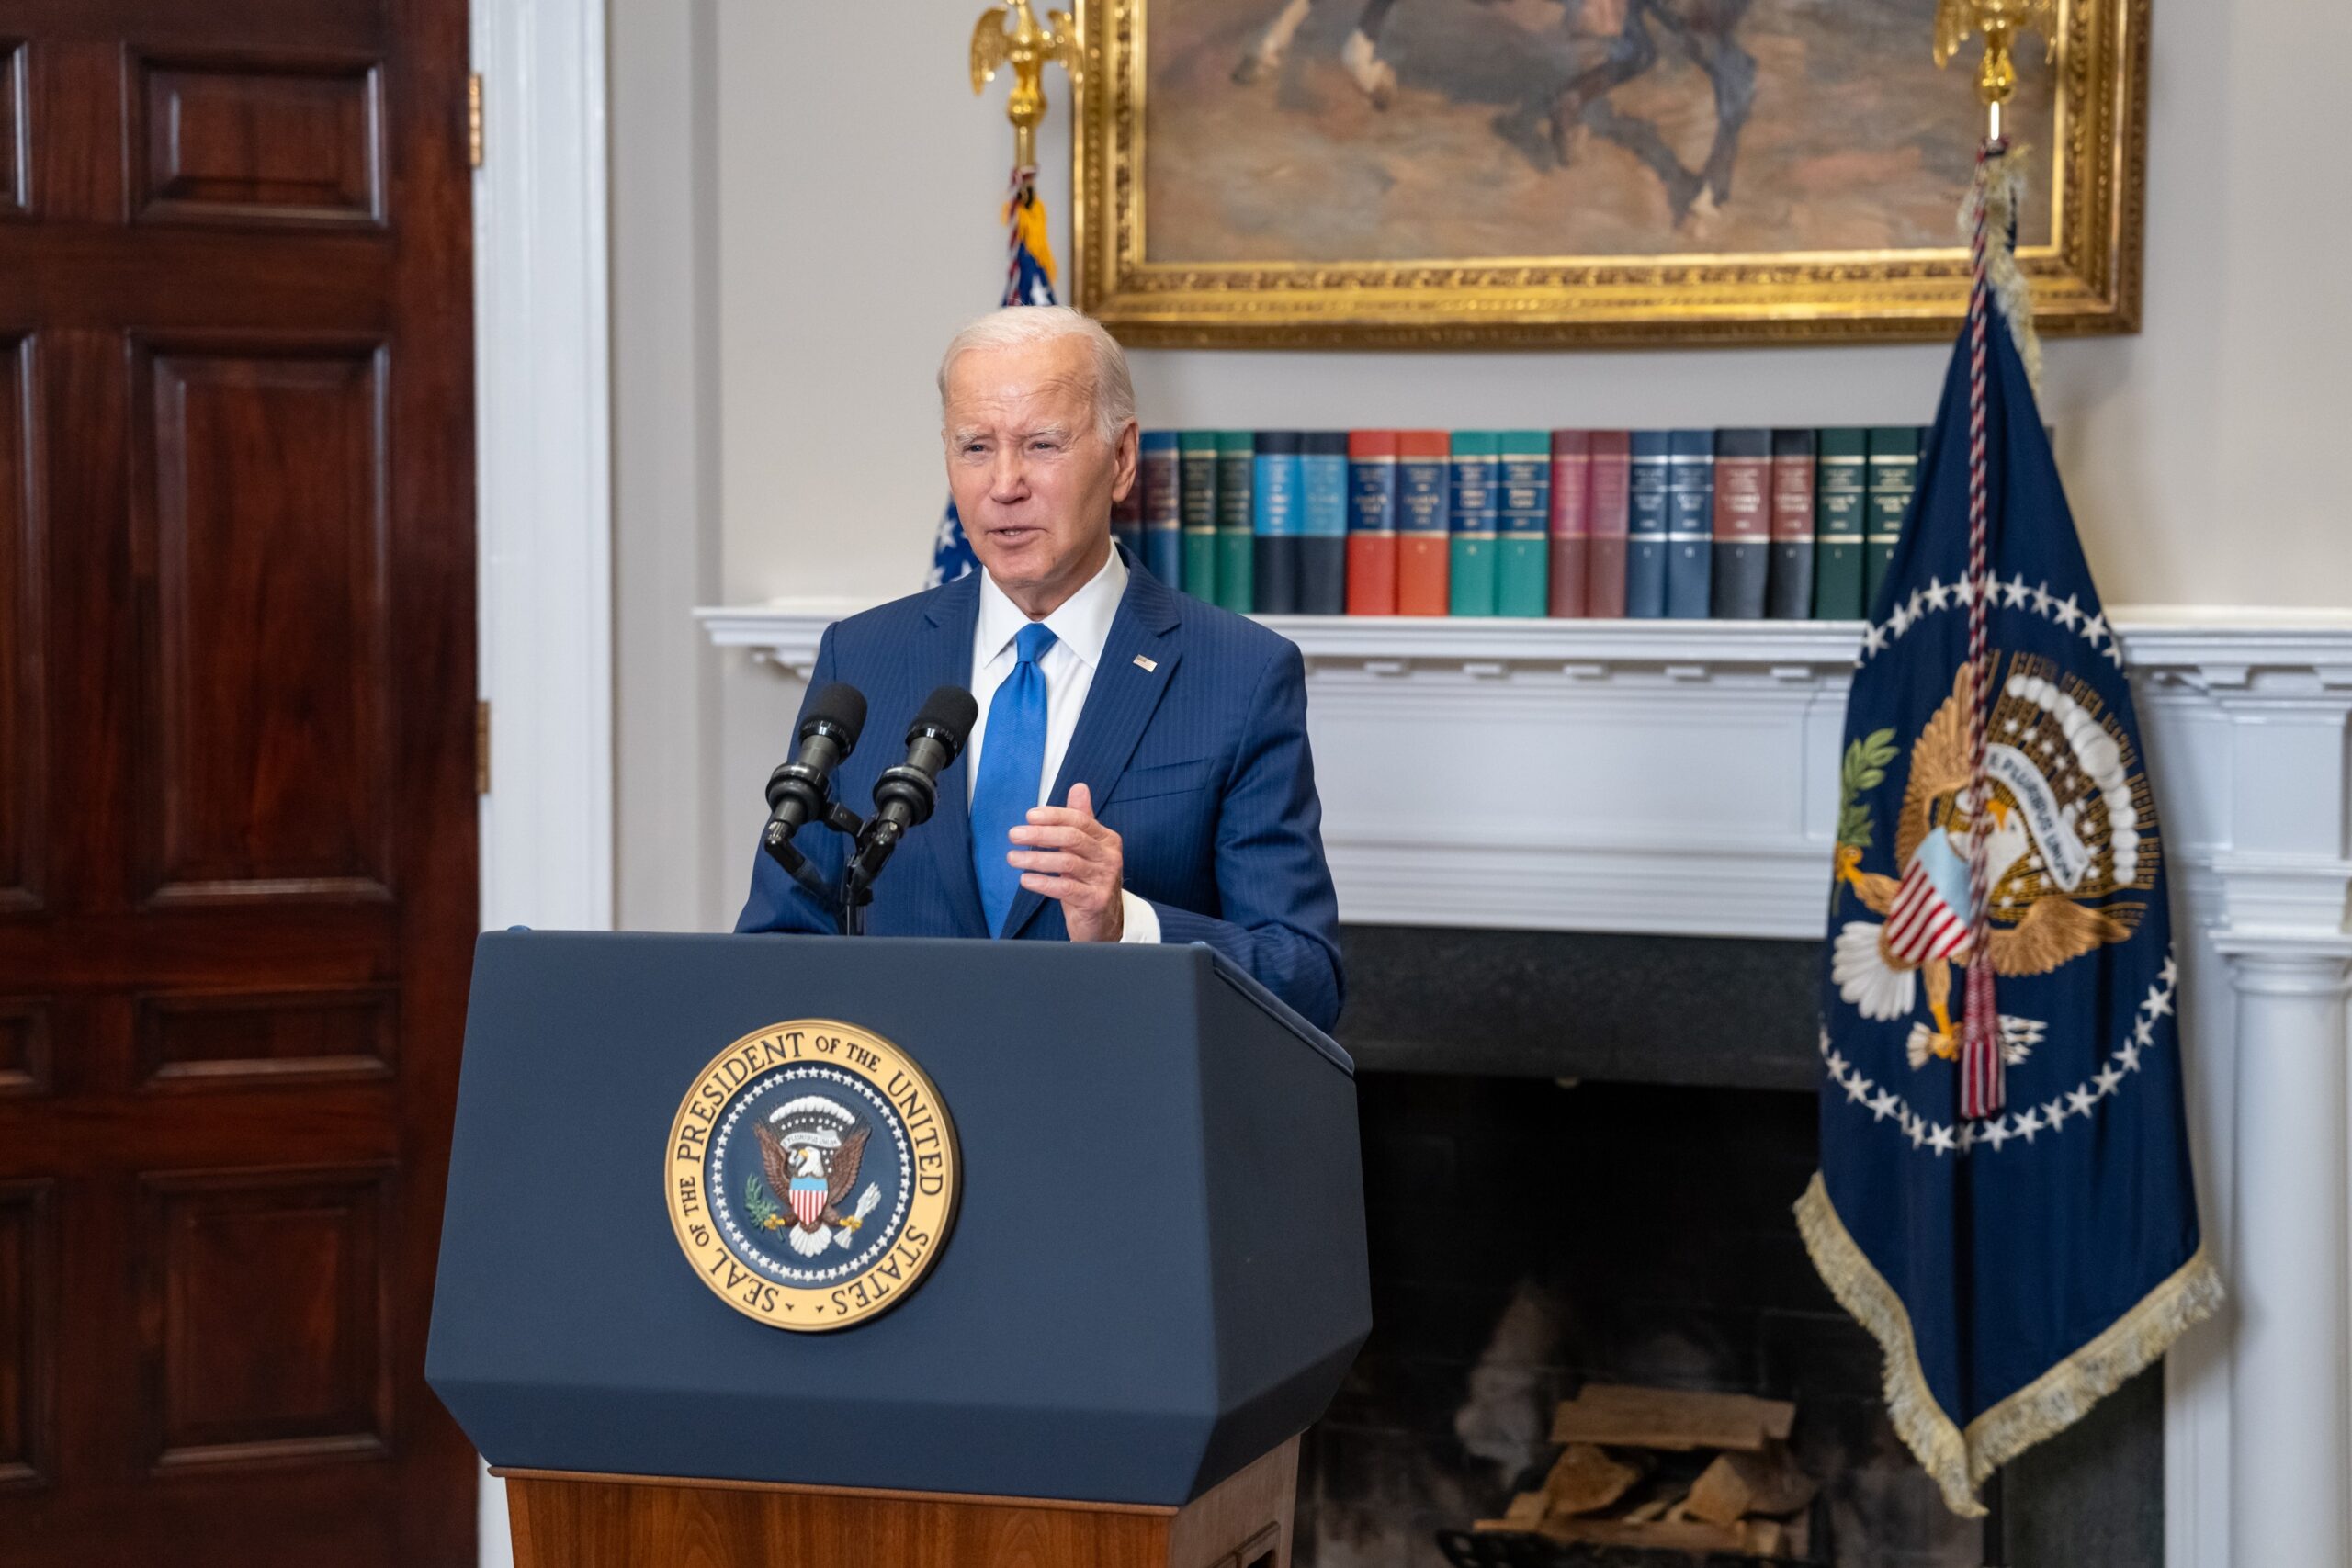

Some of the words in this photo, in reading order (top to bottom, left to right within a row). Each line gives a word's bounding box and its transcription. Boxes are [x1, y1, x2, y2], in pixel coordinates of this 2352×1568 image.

[816, 1036, 840, 1054] OF
[847, 1043, 881, 1071] THE
[678, 1032, 805, 1163] PRESIDENT
[887, 1071, 944, 1196] UNITED
[679, 1176, 699, 1217] THE
[689, 1224, 710, 1247] OF
[709, 1248, 779, 1312] SEAL
[832, 1224, 929, 1314] STATES
